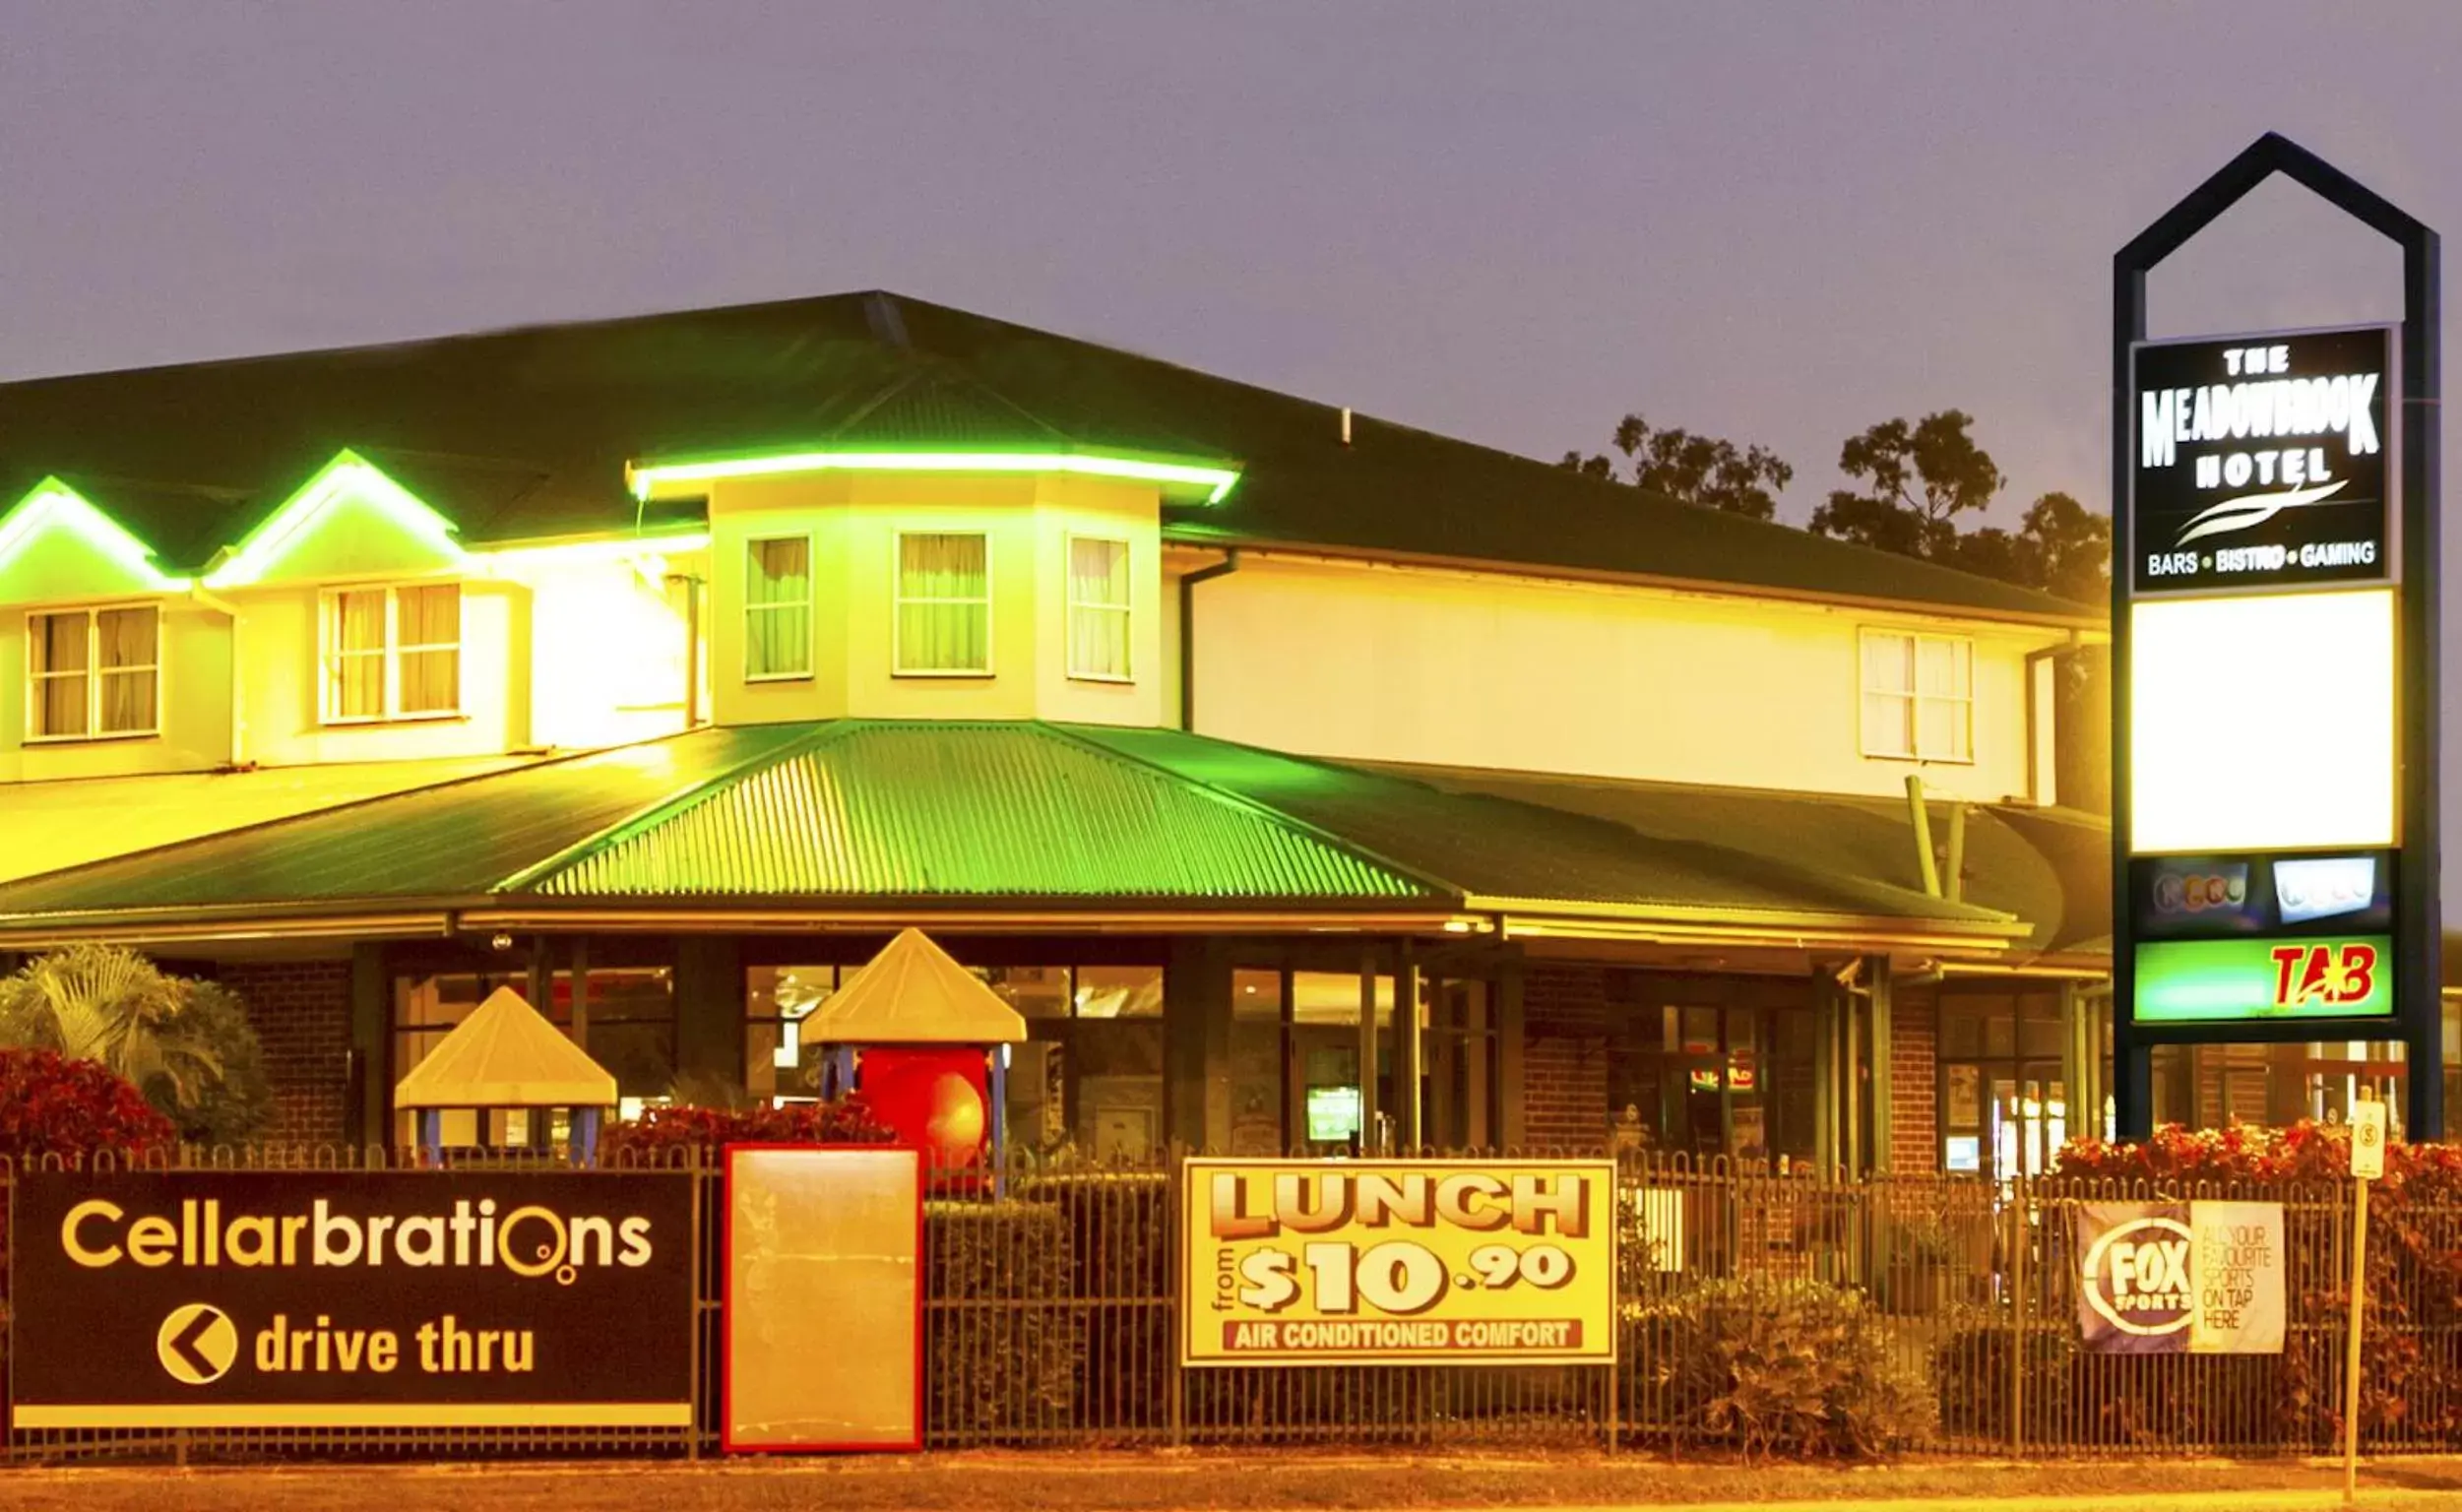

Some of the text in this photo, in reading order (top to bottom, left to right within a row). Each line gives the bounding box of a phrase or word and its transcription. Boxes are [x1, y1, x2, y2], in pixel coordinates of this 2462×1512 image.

[2223, 346, 2290, 375] THE
[2195, 448, 2332, 489] HOTEL
[2148, 540, 2375, 576] BARS BISTRO GAMING
[2270, 944, 2376, 1006] TAB
[1211, 1172, 1590, 1238] LUNCH
[61, 1199, 653, 1285] Cellarbrations
[2228, 1226, 2267, 1246] YOUR
[1211, 1248, 1235, 1311] from
[2111, 1241, 2191, 1294] FOX
[2203, 1268, 2254, 1289] SPORTS
[2115, 1293, 2193, 1312] SPORTS
[2202, 1289, 2254, 1309] ON TAP
[1234, 1323, 1570, 1349] AIR CONDITIONED COMFORT
[2203, 1309, 2241, 1331] HERE
[255, 1316, 535, 1372] drive thru
